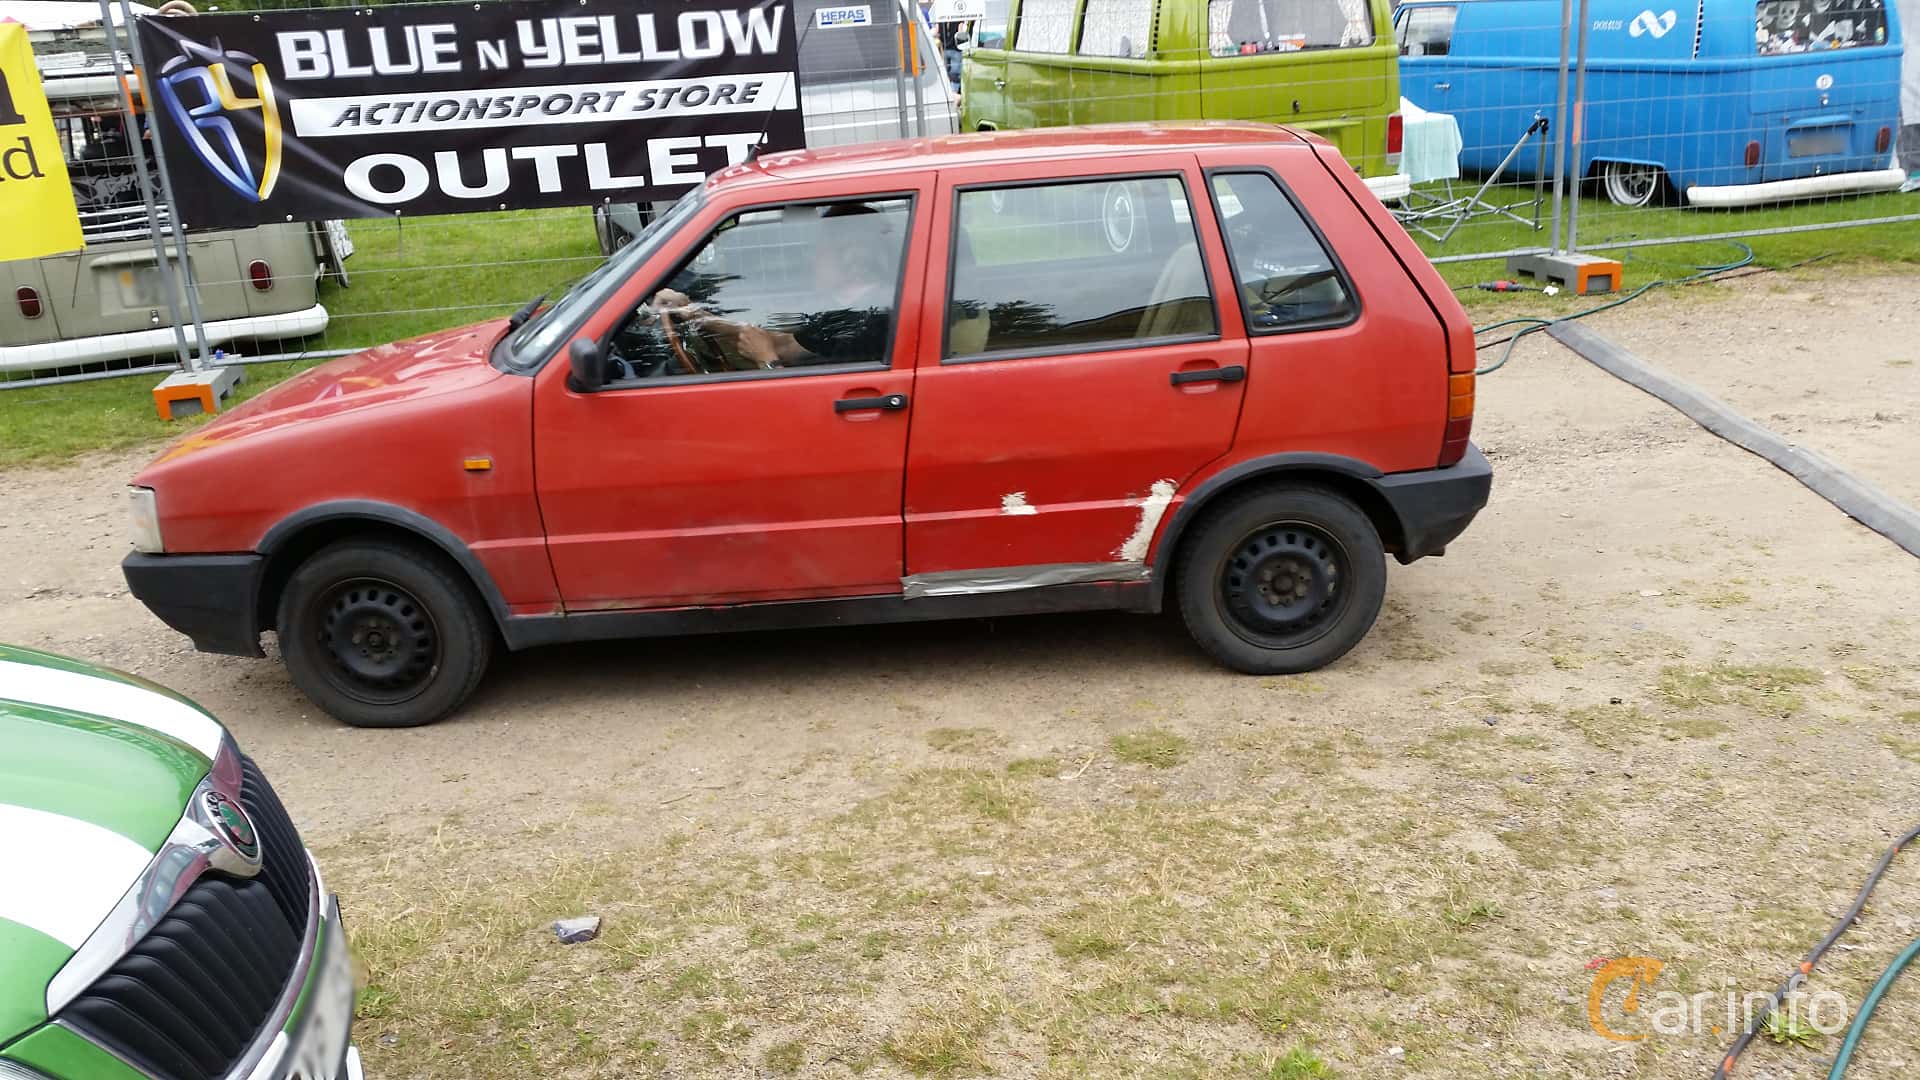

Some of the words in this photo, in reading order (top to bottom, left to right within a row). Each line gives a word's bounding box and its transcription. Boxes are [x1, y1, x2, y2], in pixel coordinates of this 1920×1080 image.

[821, 9, 865, 21] HERAS
[276, 24, 462, 80] BLUE
[476, 39, 509, 71] N
[515, 5, 785, 68] YELLOW
[331, 90, 625, 128] ACTIONSPORT
[632, 81, 763, 112] STORE
[0, 136, 46, 182] d
[344, 132, 768, 204] OUTLET
